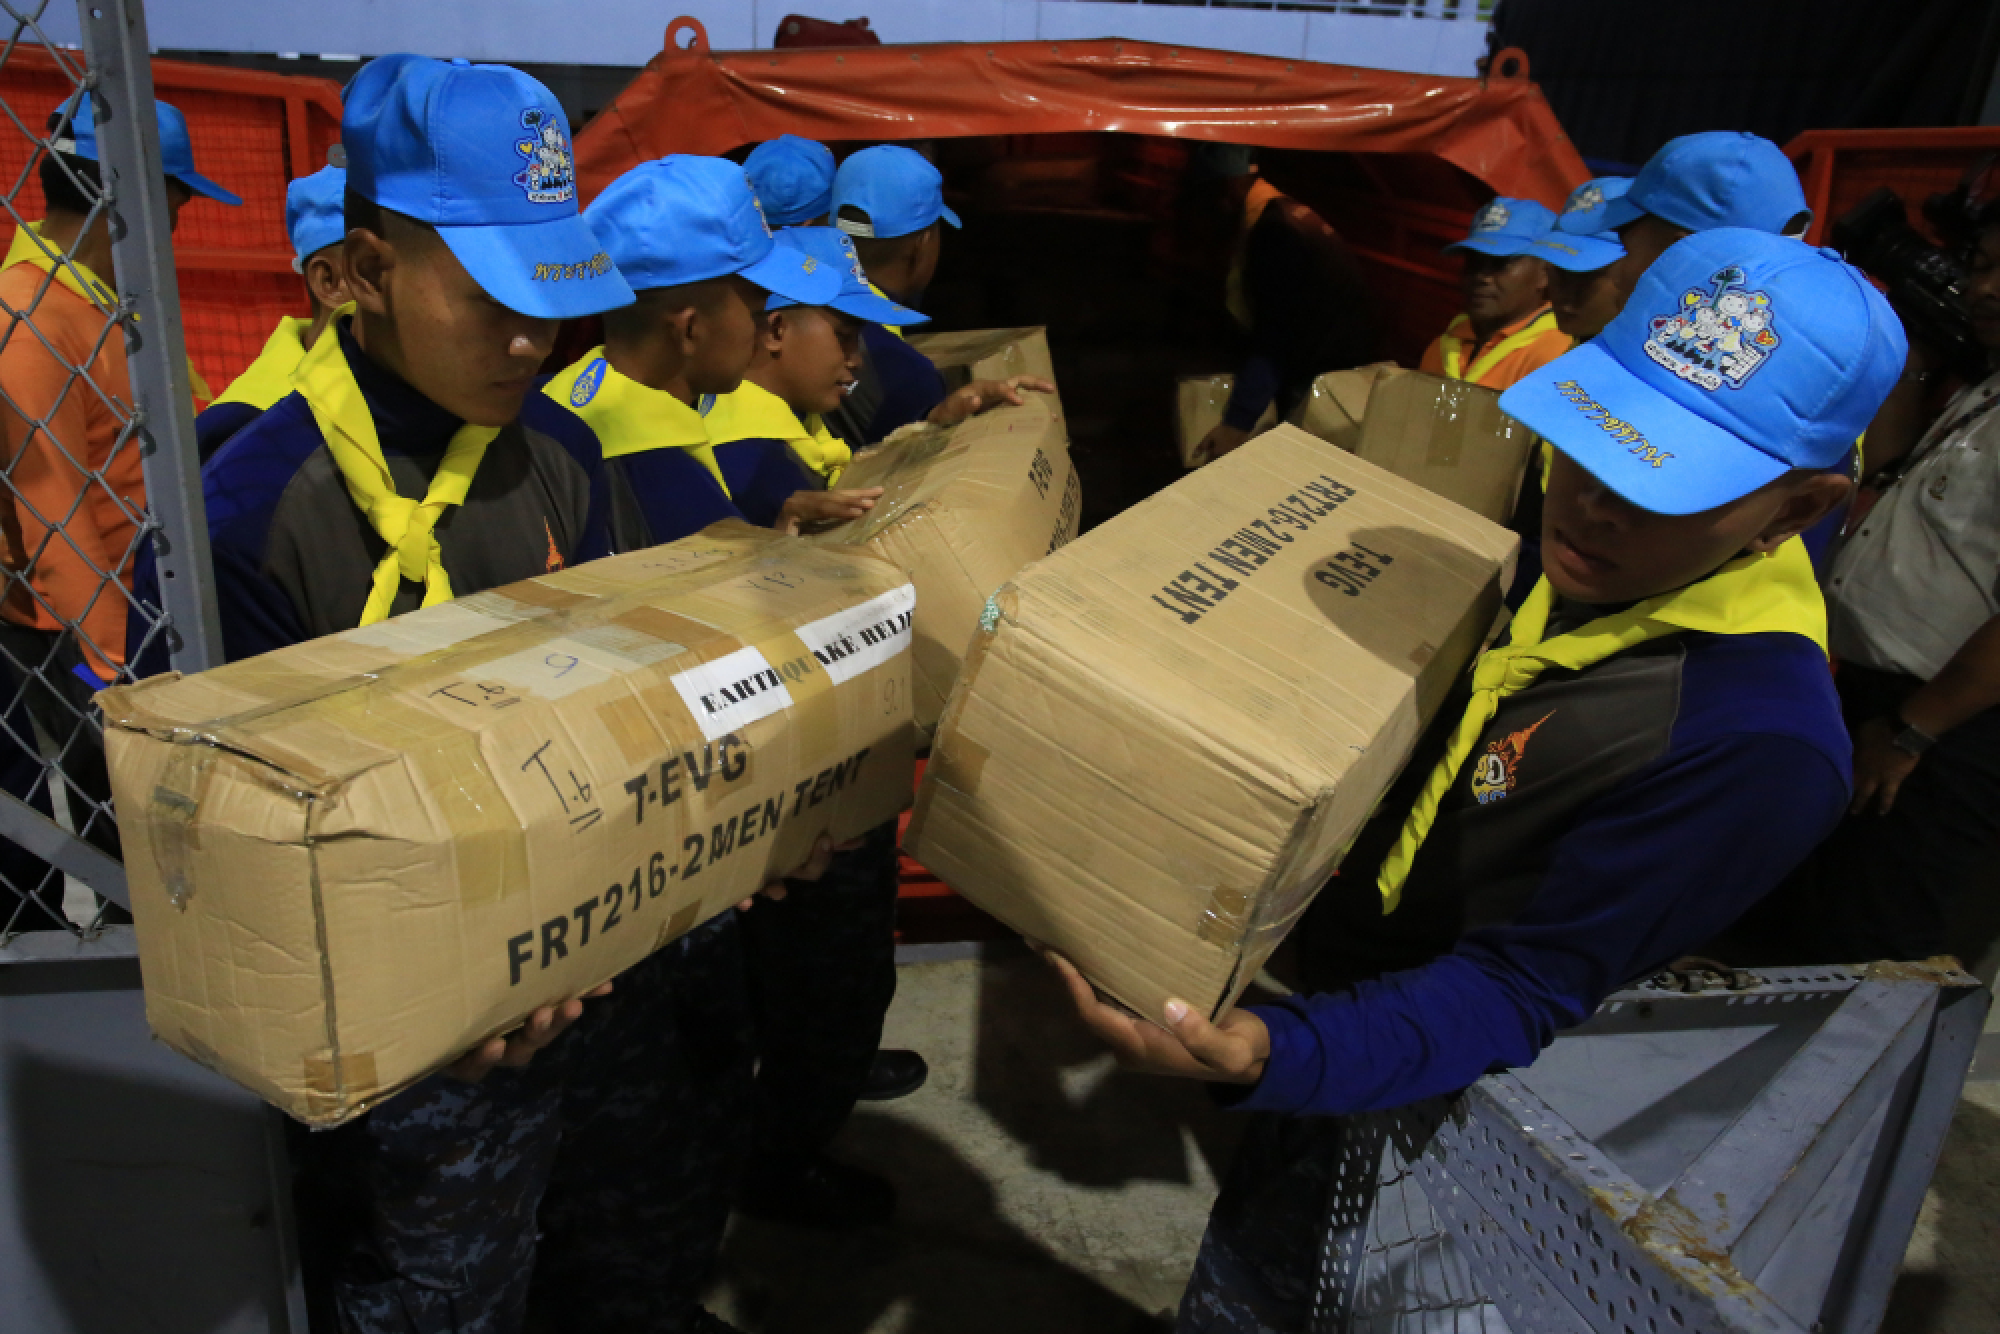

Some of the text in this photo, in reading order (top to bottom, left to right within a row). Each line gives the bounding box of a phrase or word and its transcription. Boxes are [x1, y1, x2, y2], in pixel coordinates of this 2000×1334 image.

[1150, 562, 1240, 625] TENT
[700, 634, 861, 713] EARTHQUAKE
[624, 733, 748, 826] T-EVG
[792, 747, 872, 816] TENT
